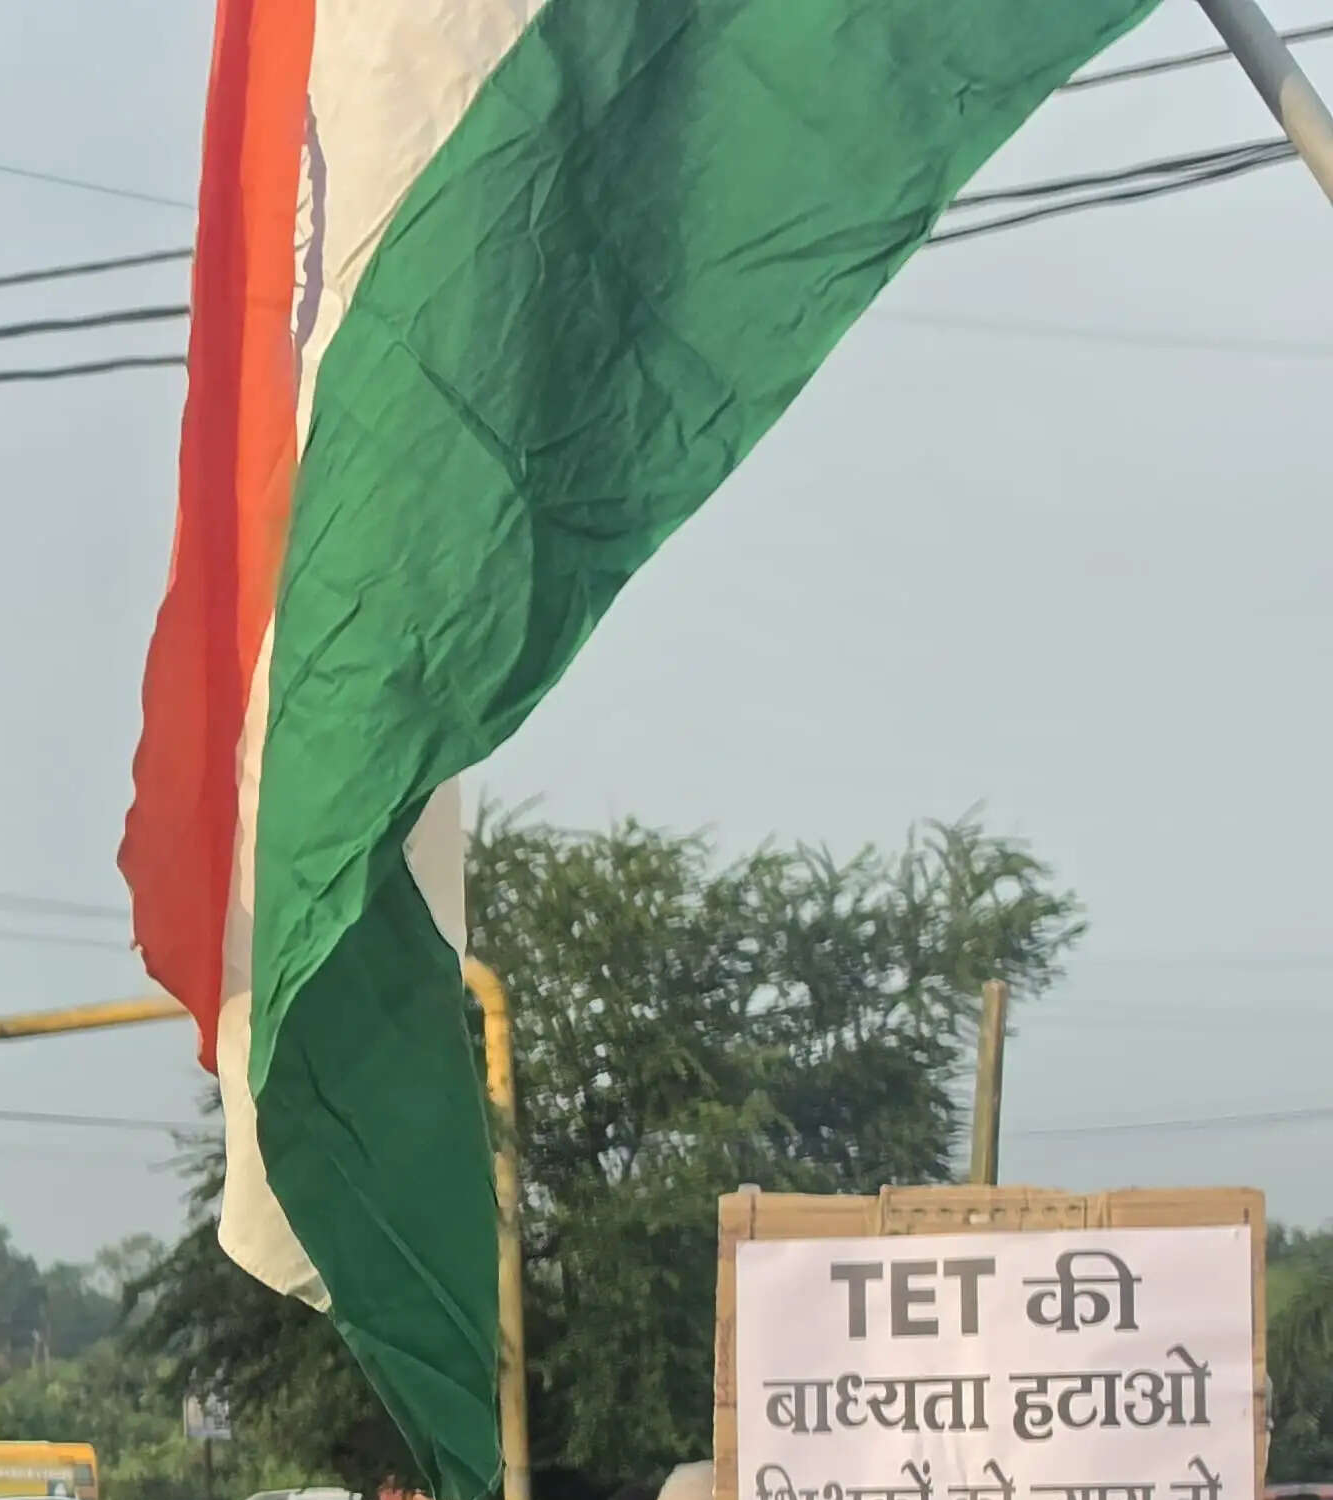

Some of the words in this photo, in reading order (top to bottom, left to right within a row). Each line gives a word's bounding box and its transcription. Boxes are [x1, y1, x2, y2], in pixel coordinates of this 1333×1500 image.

[830, 1257, 996, 1339] TET
[1023, 1249, 1142, 1333] की
[763, 1373, 990, 1434] बाध्यता
[1009, 1345, 1212, 1440] हटाओ
